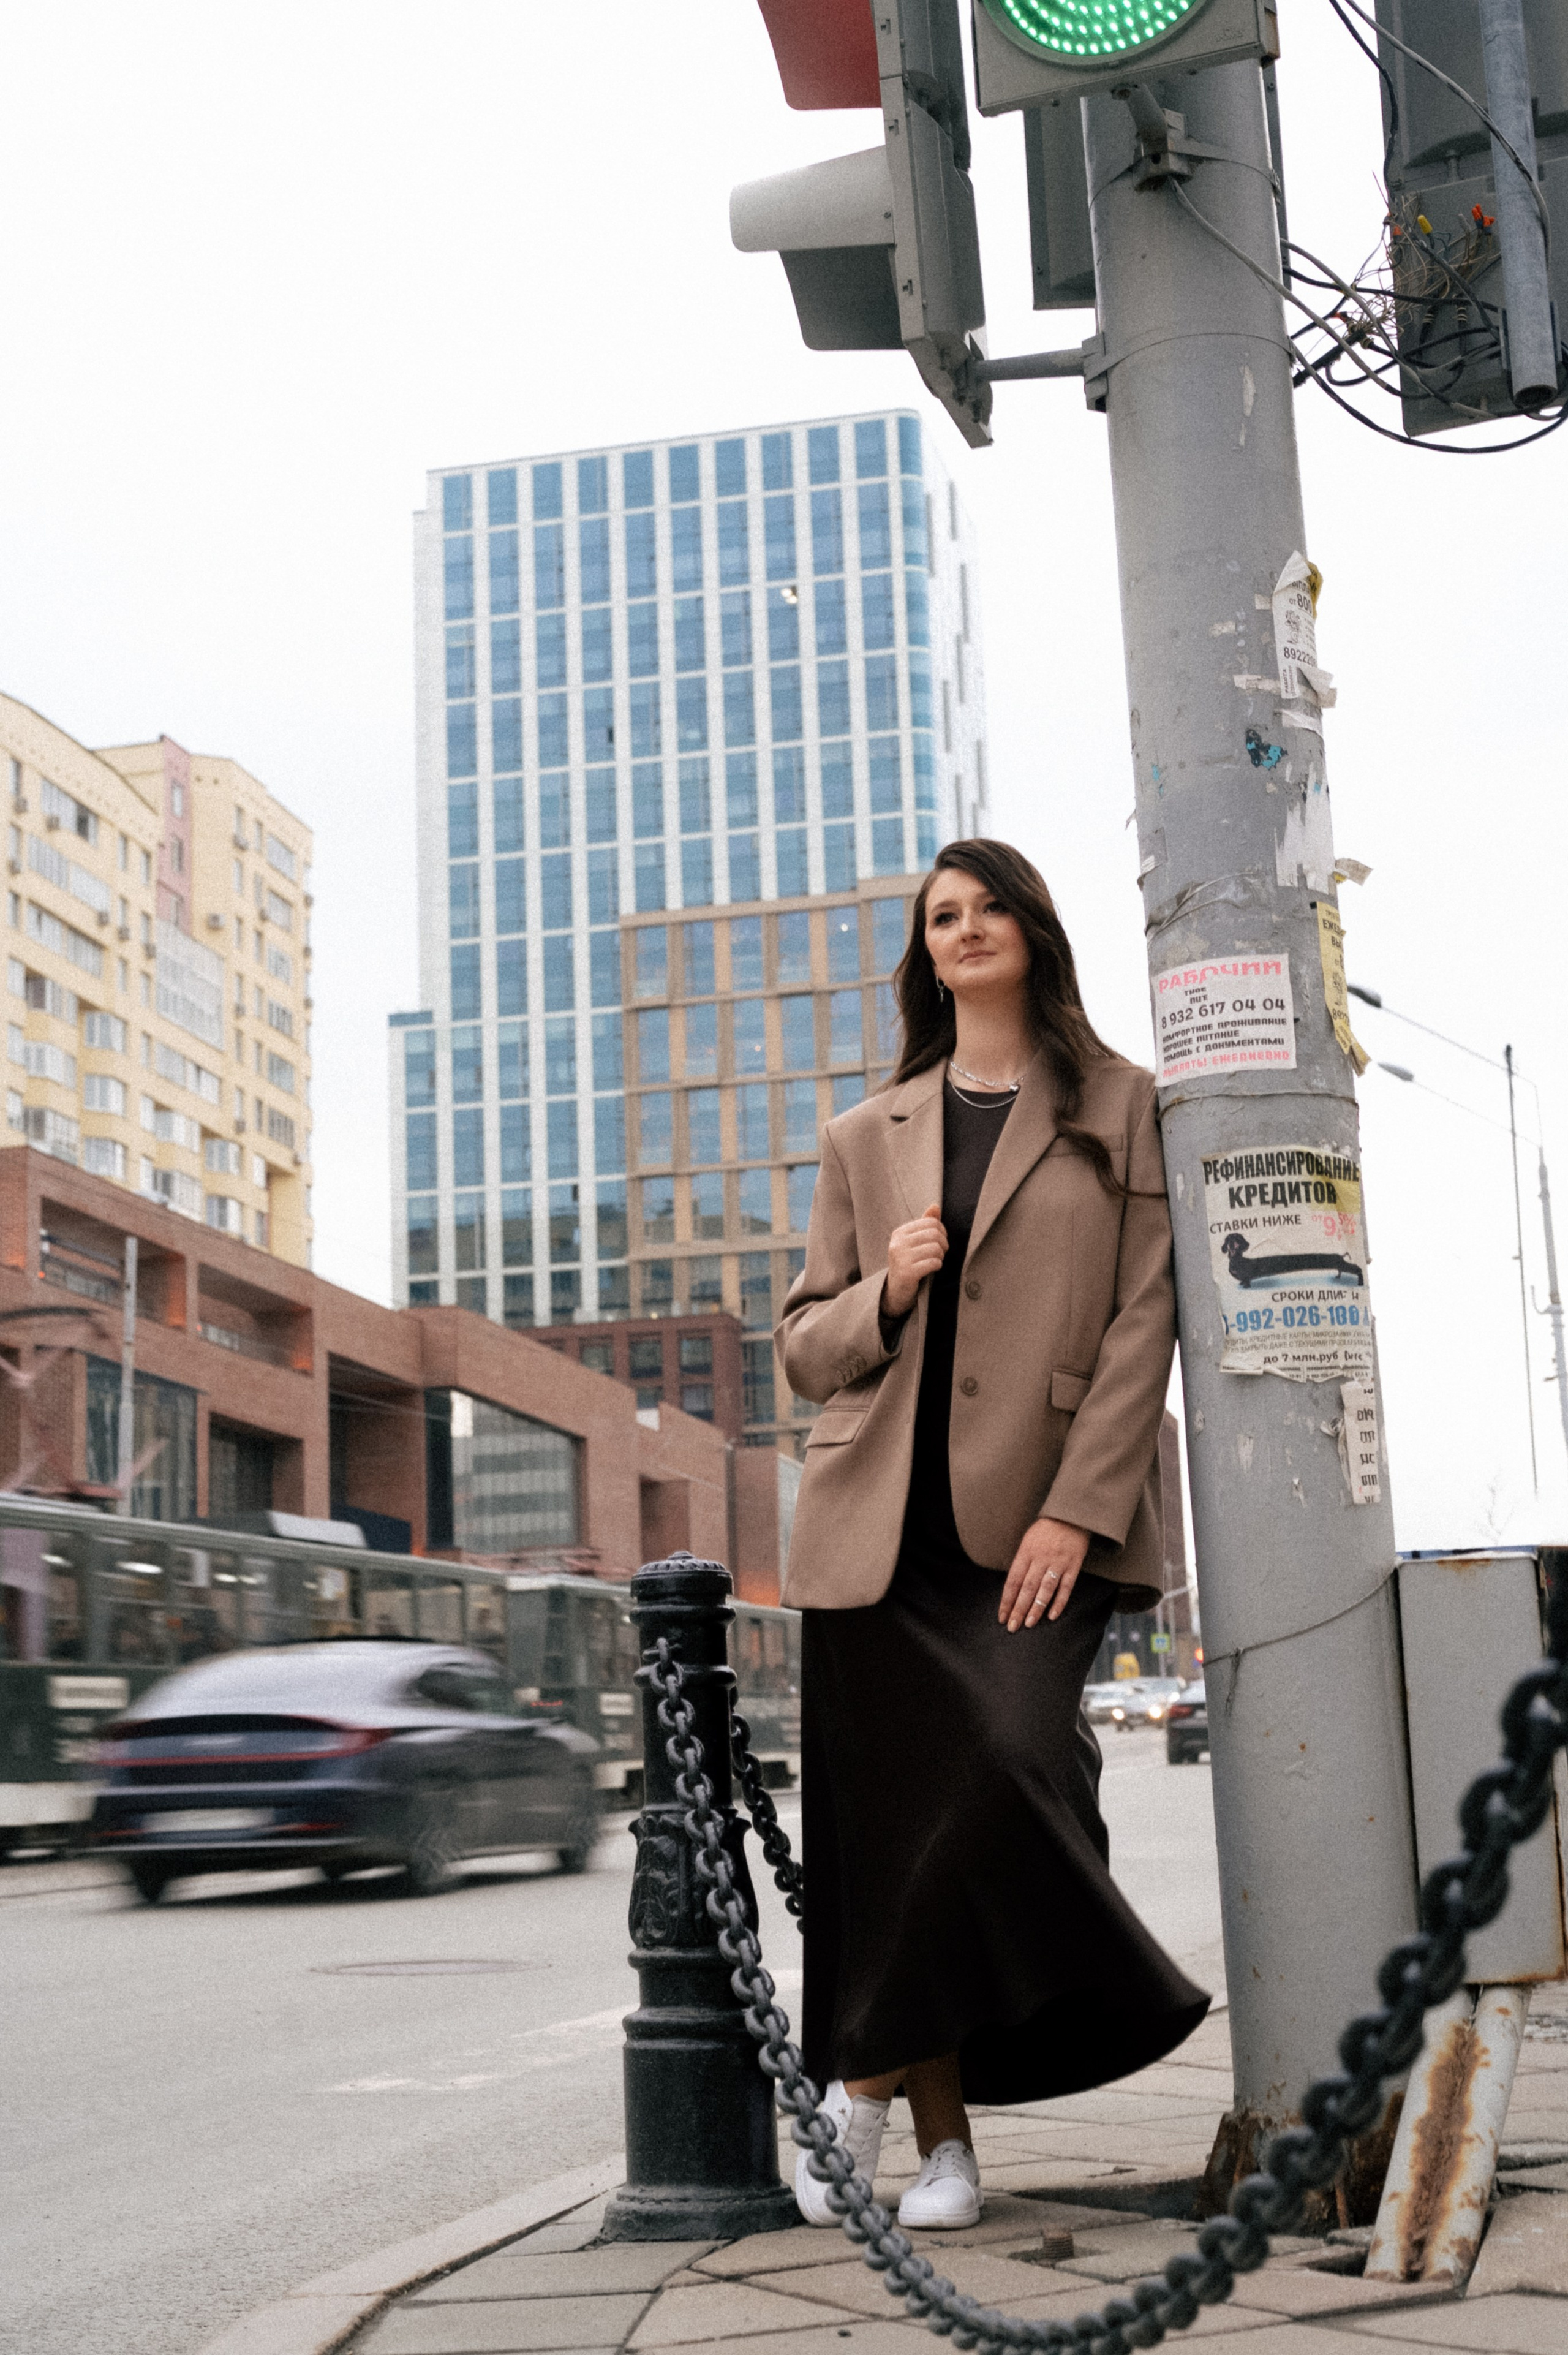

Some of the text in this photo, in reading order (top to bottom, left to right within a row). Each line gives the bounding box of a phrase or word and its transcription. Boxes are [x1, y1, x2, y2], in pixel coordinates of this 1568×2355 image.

[1161, 998, 1285, 1029] 8 932 617 04 04
[1163, 1018, 1287, 1043] КОМФОРТНОЕ ПРОЖИВАНИЕ
[1163, 1030, 1240, 1053] ХОРОШЕЕ ПИТАНИЕ
[1164, 1048, 1193, 1063] ПОМОЩЬ
[1205, 1038, 1285, 1052] ДОКУМЕНТАМИ
[1212, 1050, 1290, 1065] ЕЖЕДНЕВНО
[1203, 1151, 1360, 1185] РЕФИНАНСИРОВАНИЕ
[1228, 1181, 1337, 1209] КРЕДИТОВ
[1210, 1217, 1259, 1234] СТАВКИ
[1262, 1214, 1302, 1227] НИЖЕ
[1272, 1291, 1314, 1302] СРОКИ
[1263, 1354, 1279, 1364] до
[1282, 1353, 1289, 1362] 7
